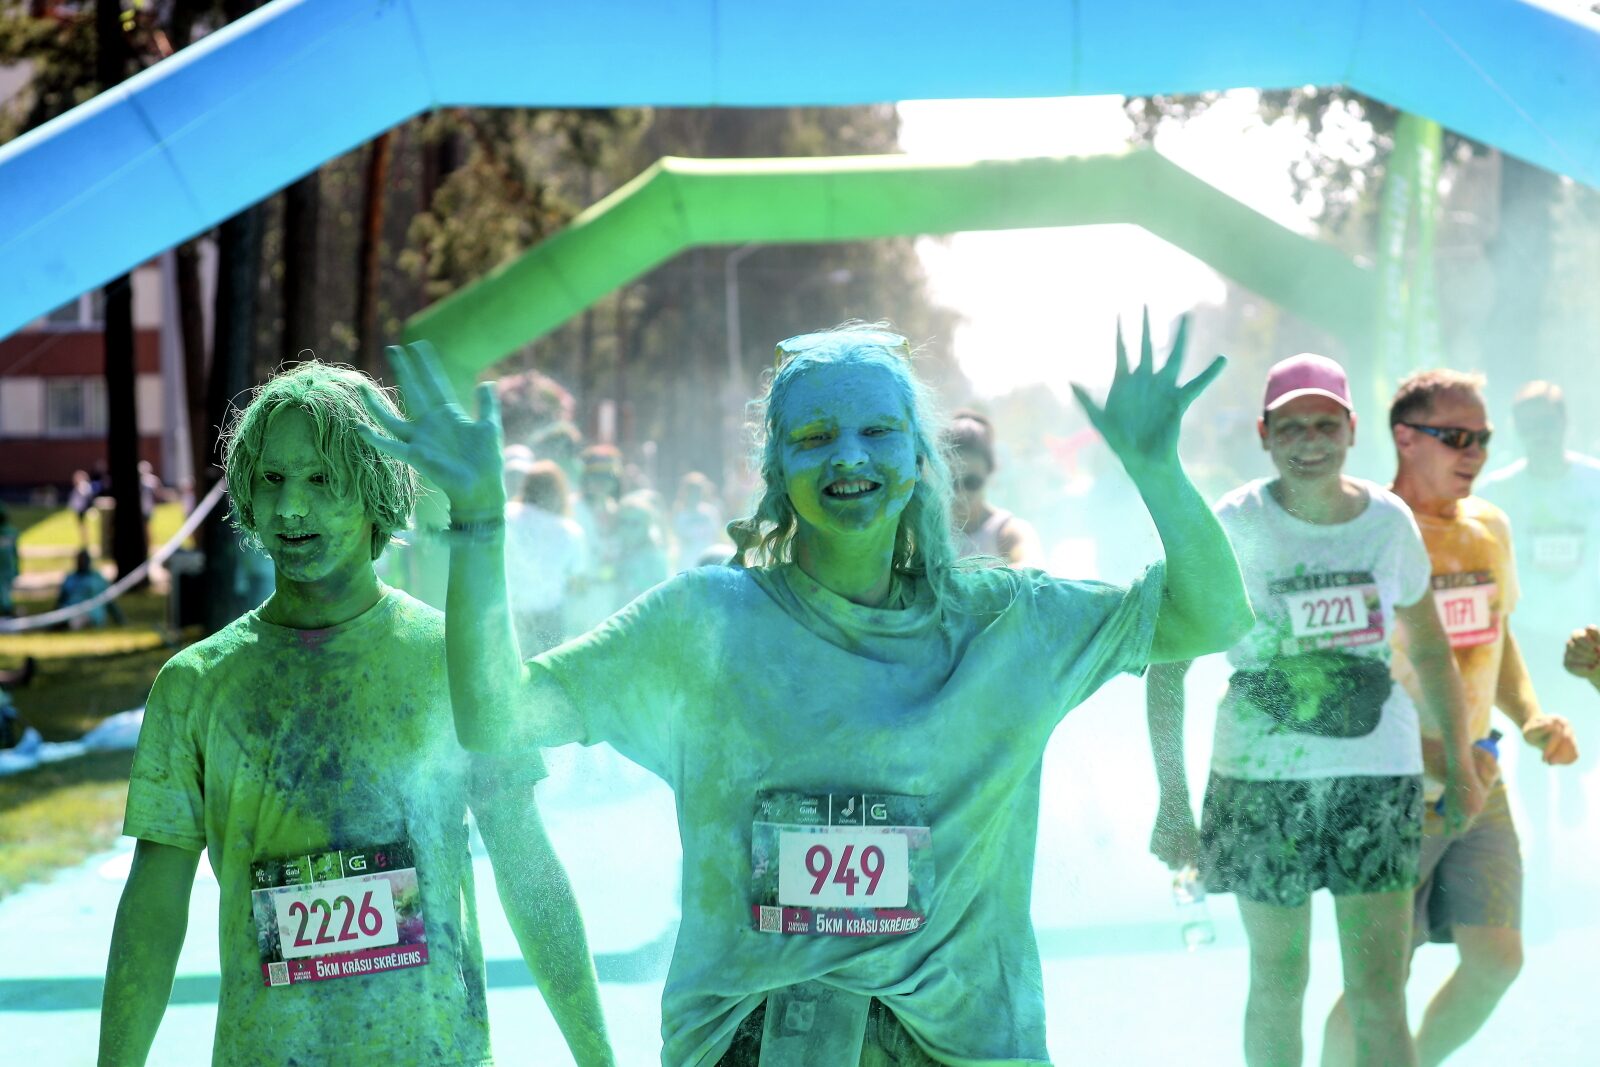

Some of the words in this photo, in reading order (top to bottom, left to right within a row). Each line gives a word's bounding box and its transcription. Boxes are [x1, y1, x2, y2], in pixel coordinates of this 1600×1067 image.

[1302, 595, 1355, 628] 2221
[1444, 597, 1476, 627] 1171
[805, 844, 885, 896] 949
[289, 891, 383, 948] 2226
[816, 913, 843, 933] 5KM
[846, 916, 878, 933] KRĀSU
[316, 960, 341, 978] 5KM
[342, 959, 372, 975] KRĀSU
[374, 951, 421, 970] SKRĒJIENS
